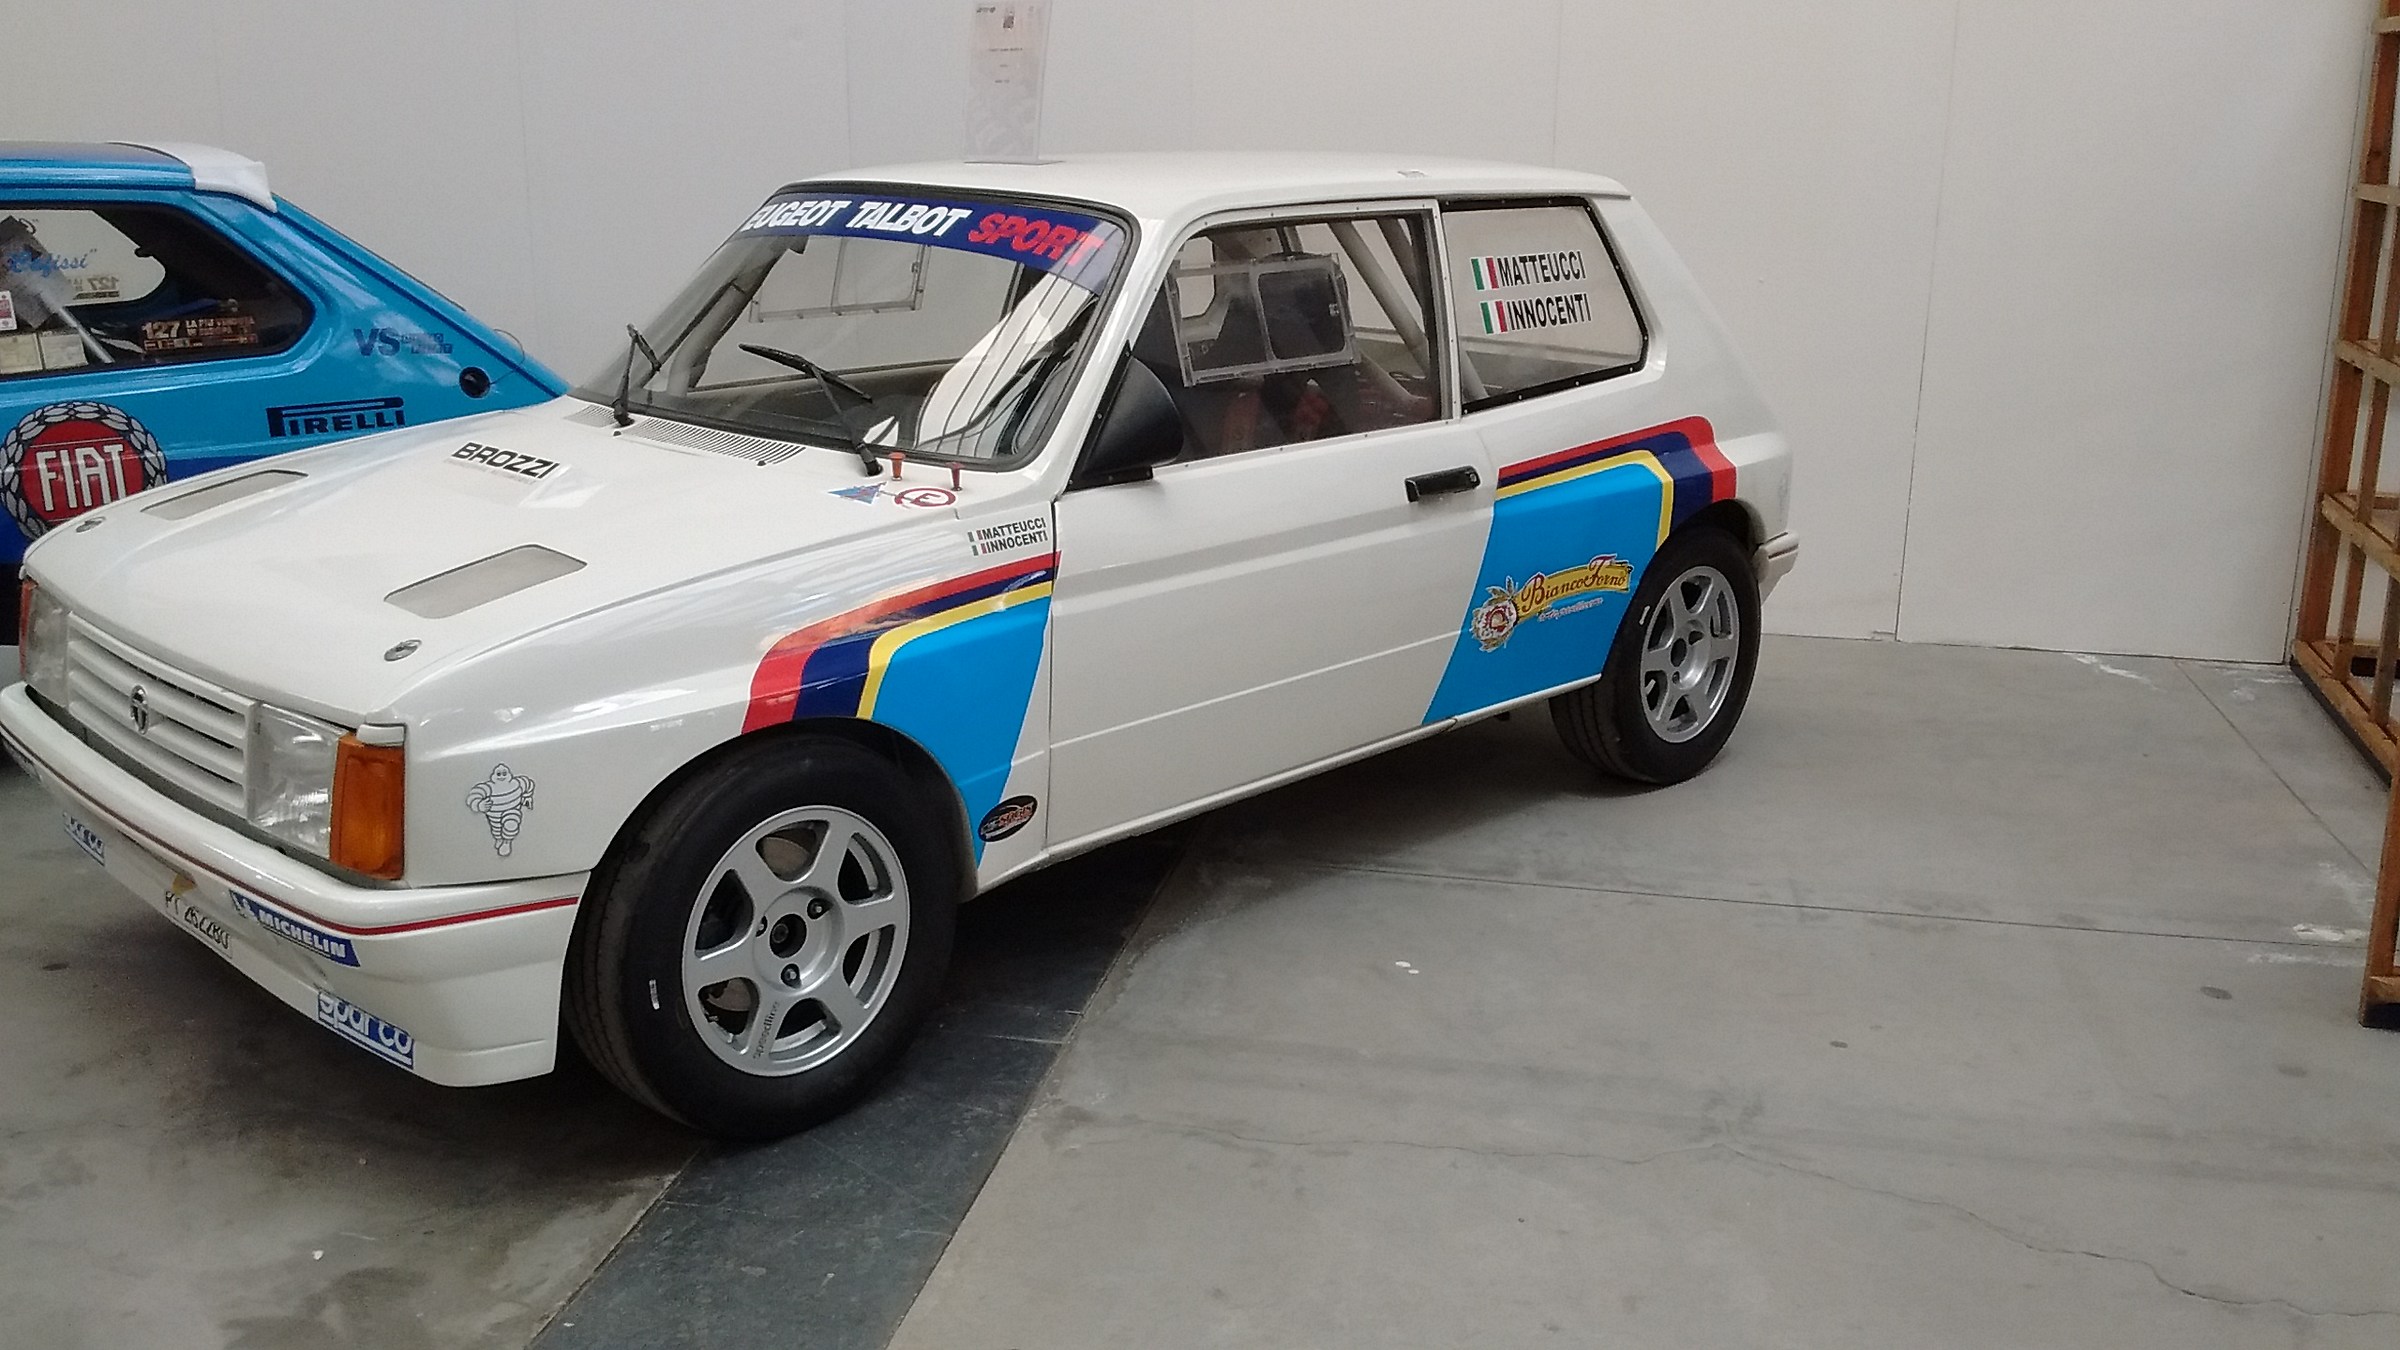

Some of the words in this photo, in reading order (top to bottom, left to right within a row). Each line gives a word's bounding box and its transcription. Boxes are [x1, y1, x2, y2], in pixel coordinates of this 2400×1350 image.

[846, 201, 972, 237] TALBOT
[968, 212, 1104, 267] SPORT
[1497, 251, 1586, 287] MATTEUCCI
[142, 321, 180, 340] 127
[1506, 293, 1591, 331] INNOCENTI
[353, 328, 400, 356] VS
[266, 396, 406, 437] PIRELLI
[36, 444, 127, 511] FIAT
[451, 442, 561, 479] BROZZI
[981, 517, 1047, 540] MATTEUCCI
[986, 530, 1048, 554] INNOCENTI
[259, 910, 346, 959] MICHELIN
[320, 992, 413, 1055] sparco
